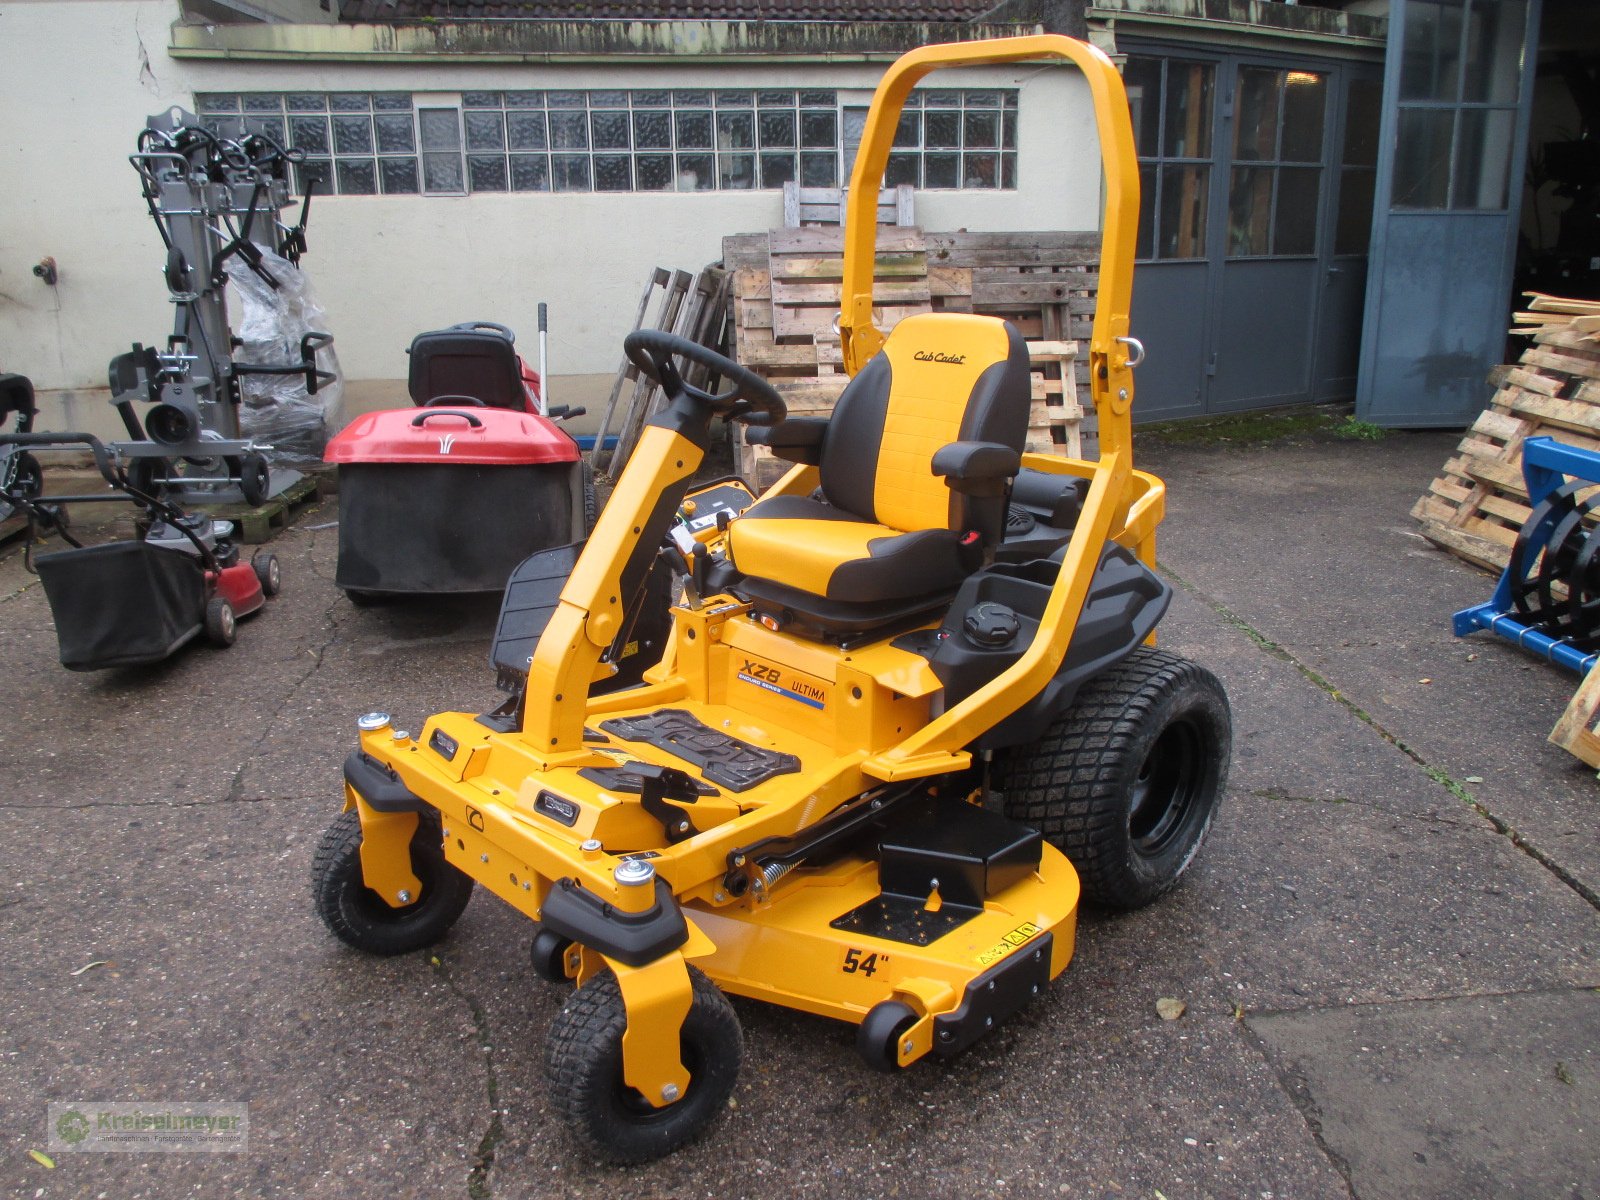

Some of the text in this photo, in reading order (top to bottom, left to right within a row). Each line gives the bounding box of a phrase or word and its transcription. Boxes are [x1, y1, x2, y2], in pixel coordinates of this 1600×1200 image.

[914, 350, 966, 364] Cub Cadet
[738, 674, 761, 685] ENDURO
[740, 659, 781, 684] XZ8
[792, 681, 825, 702] ULTIMA
[842, 947, 889, 978] 54"
